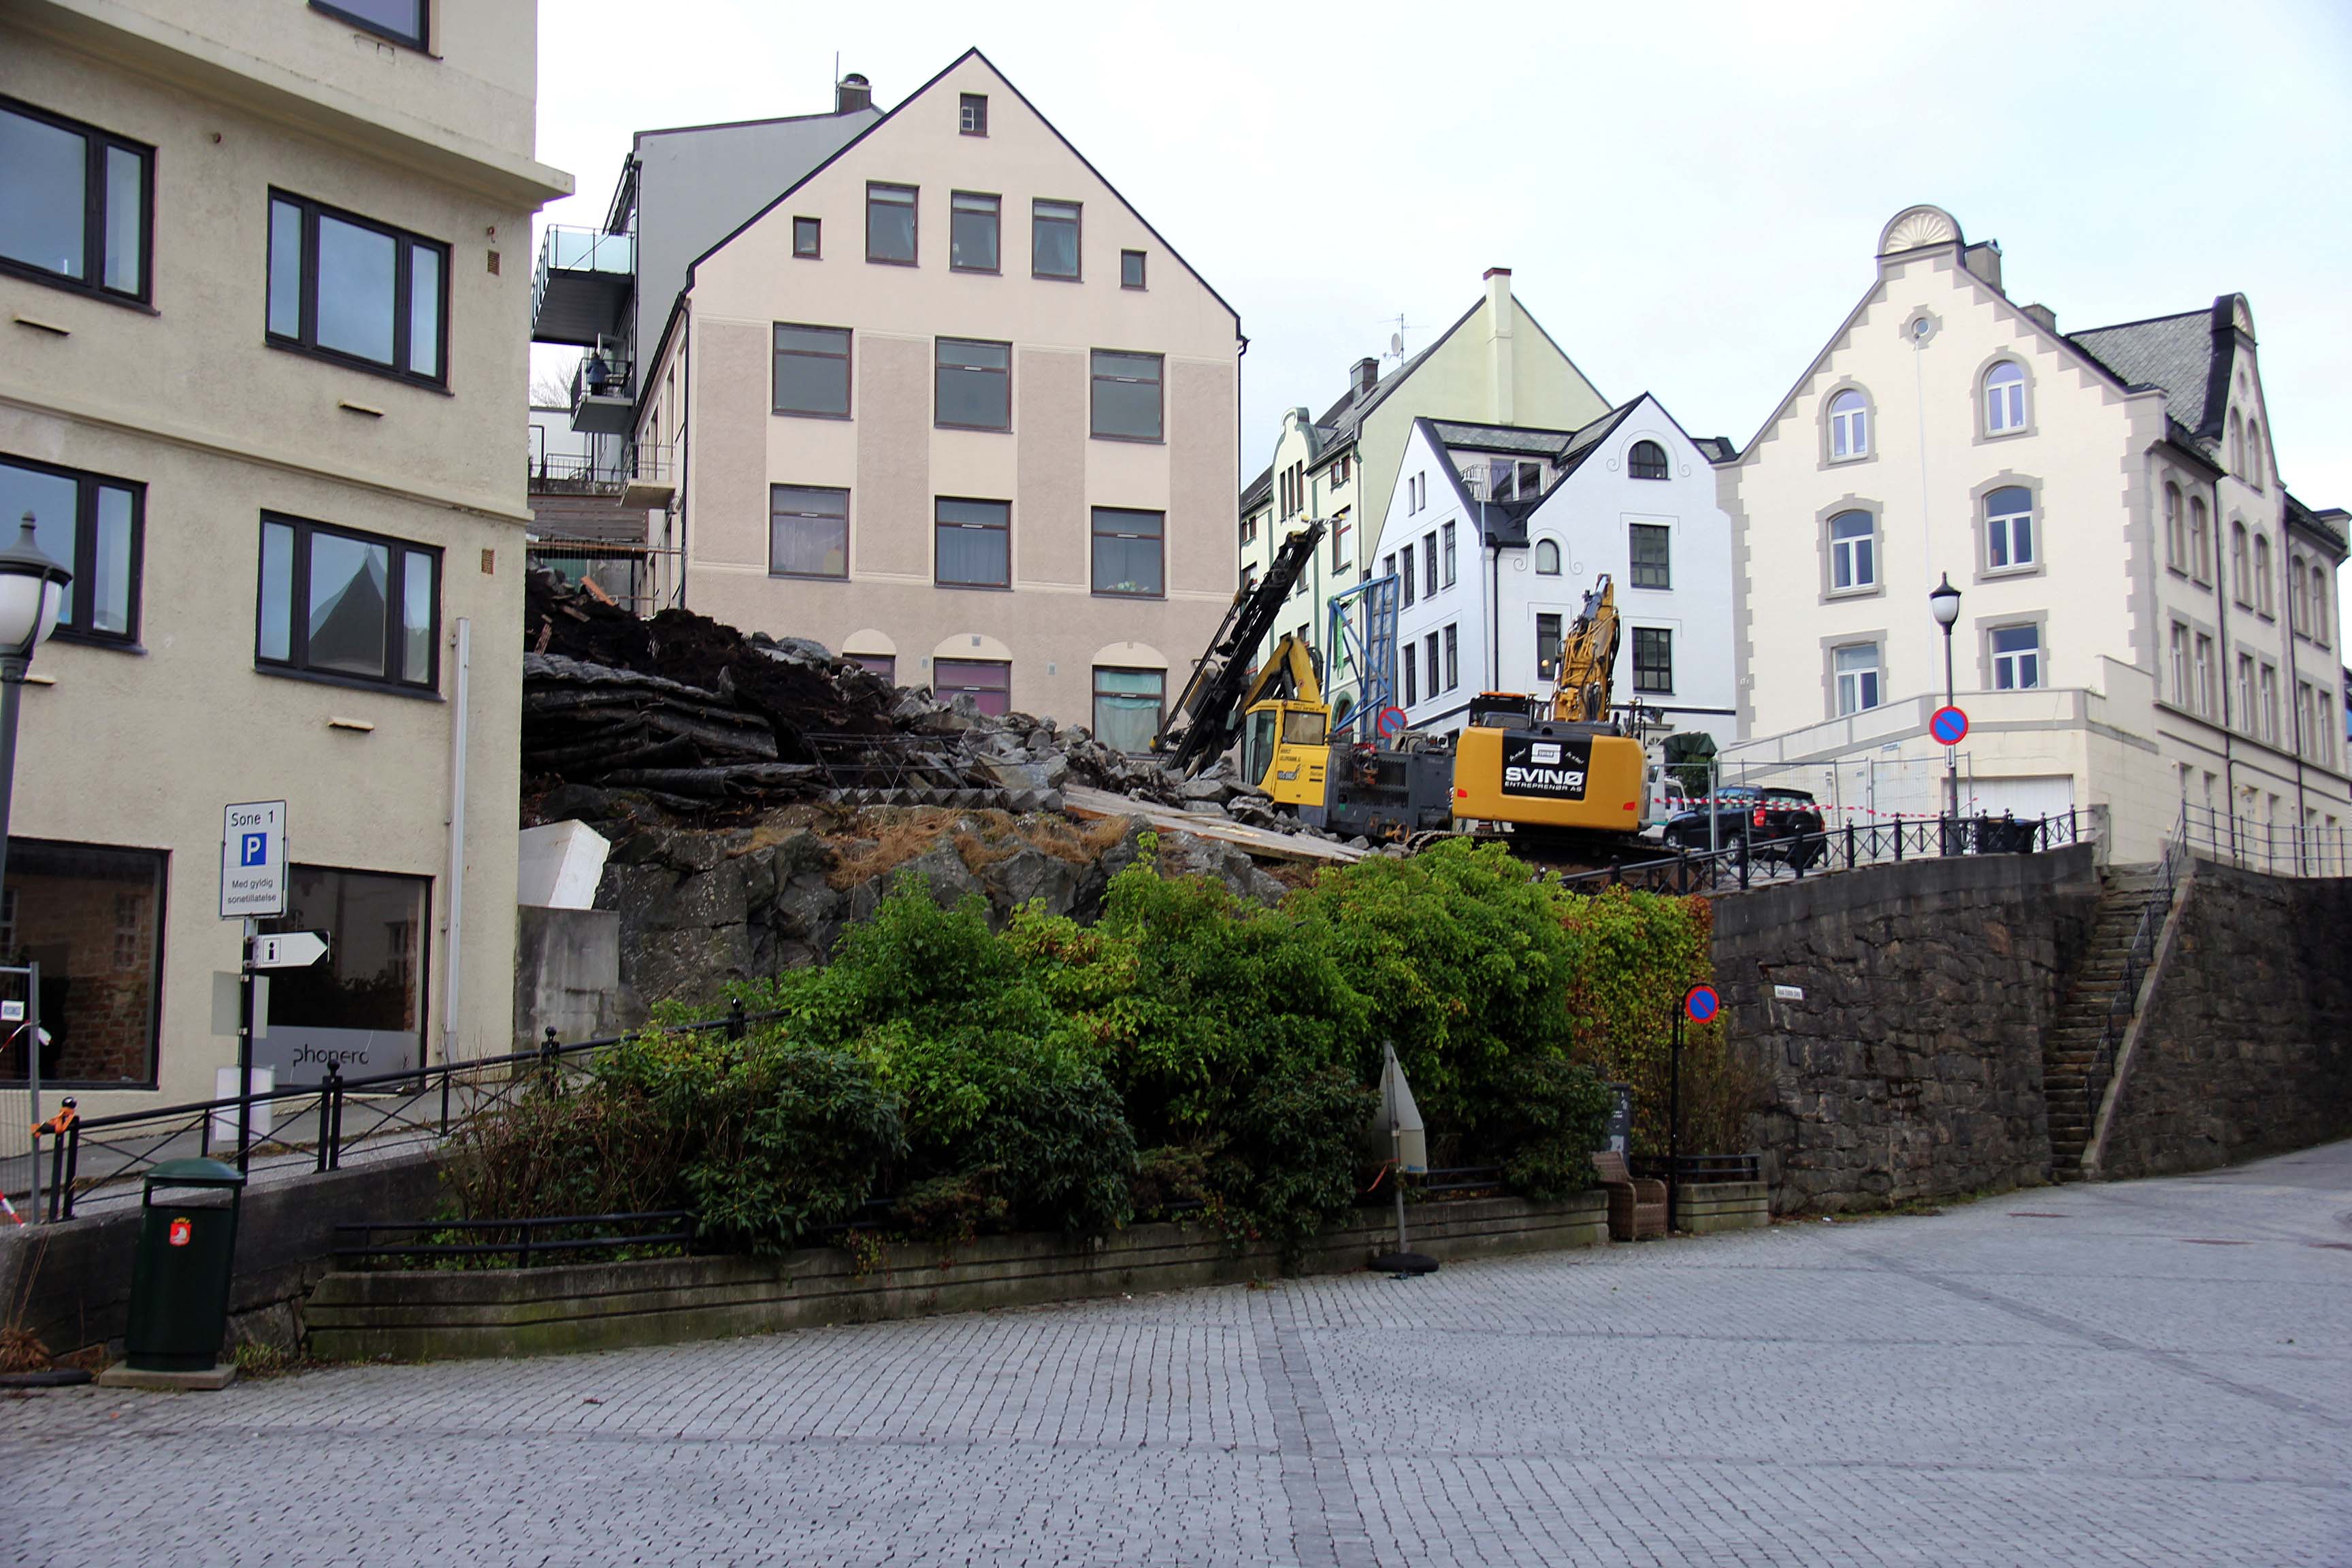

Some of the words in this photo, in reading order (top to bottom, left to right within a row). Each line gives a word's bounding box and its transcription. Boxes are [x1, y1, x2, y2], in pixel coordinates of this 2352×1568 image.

[1505, 766, 1584, 786] SVINØ
[231, 813, 261, 827] Sone
[268, 809, 274, 823] 1
[246, 836, 261, 863] P
[232, 879, 248, 888] Med
[250, 878, 274, 889] gyldig
[227, 894, 277, 904] sonetillatelse
